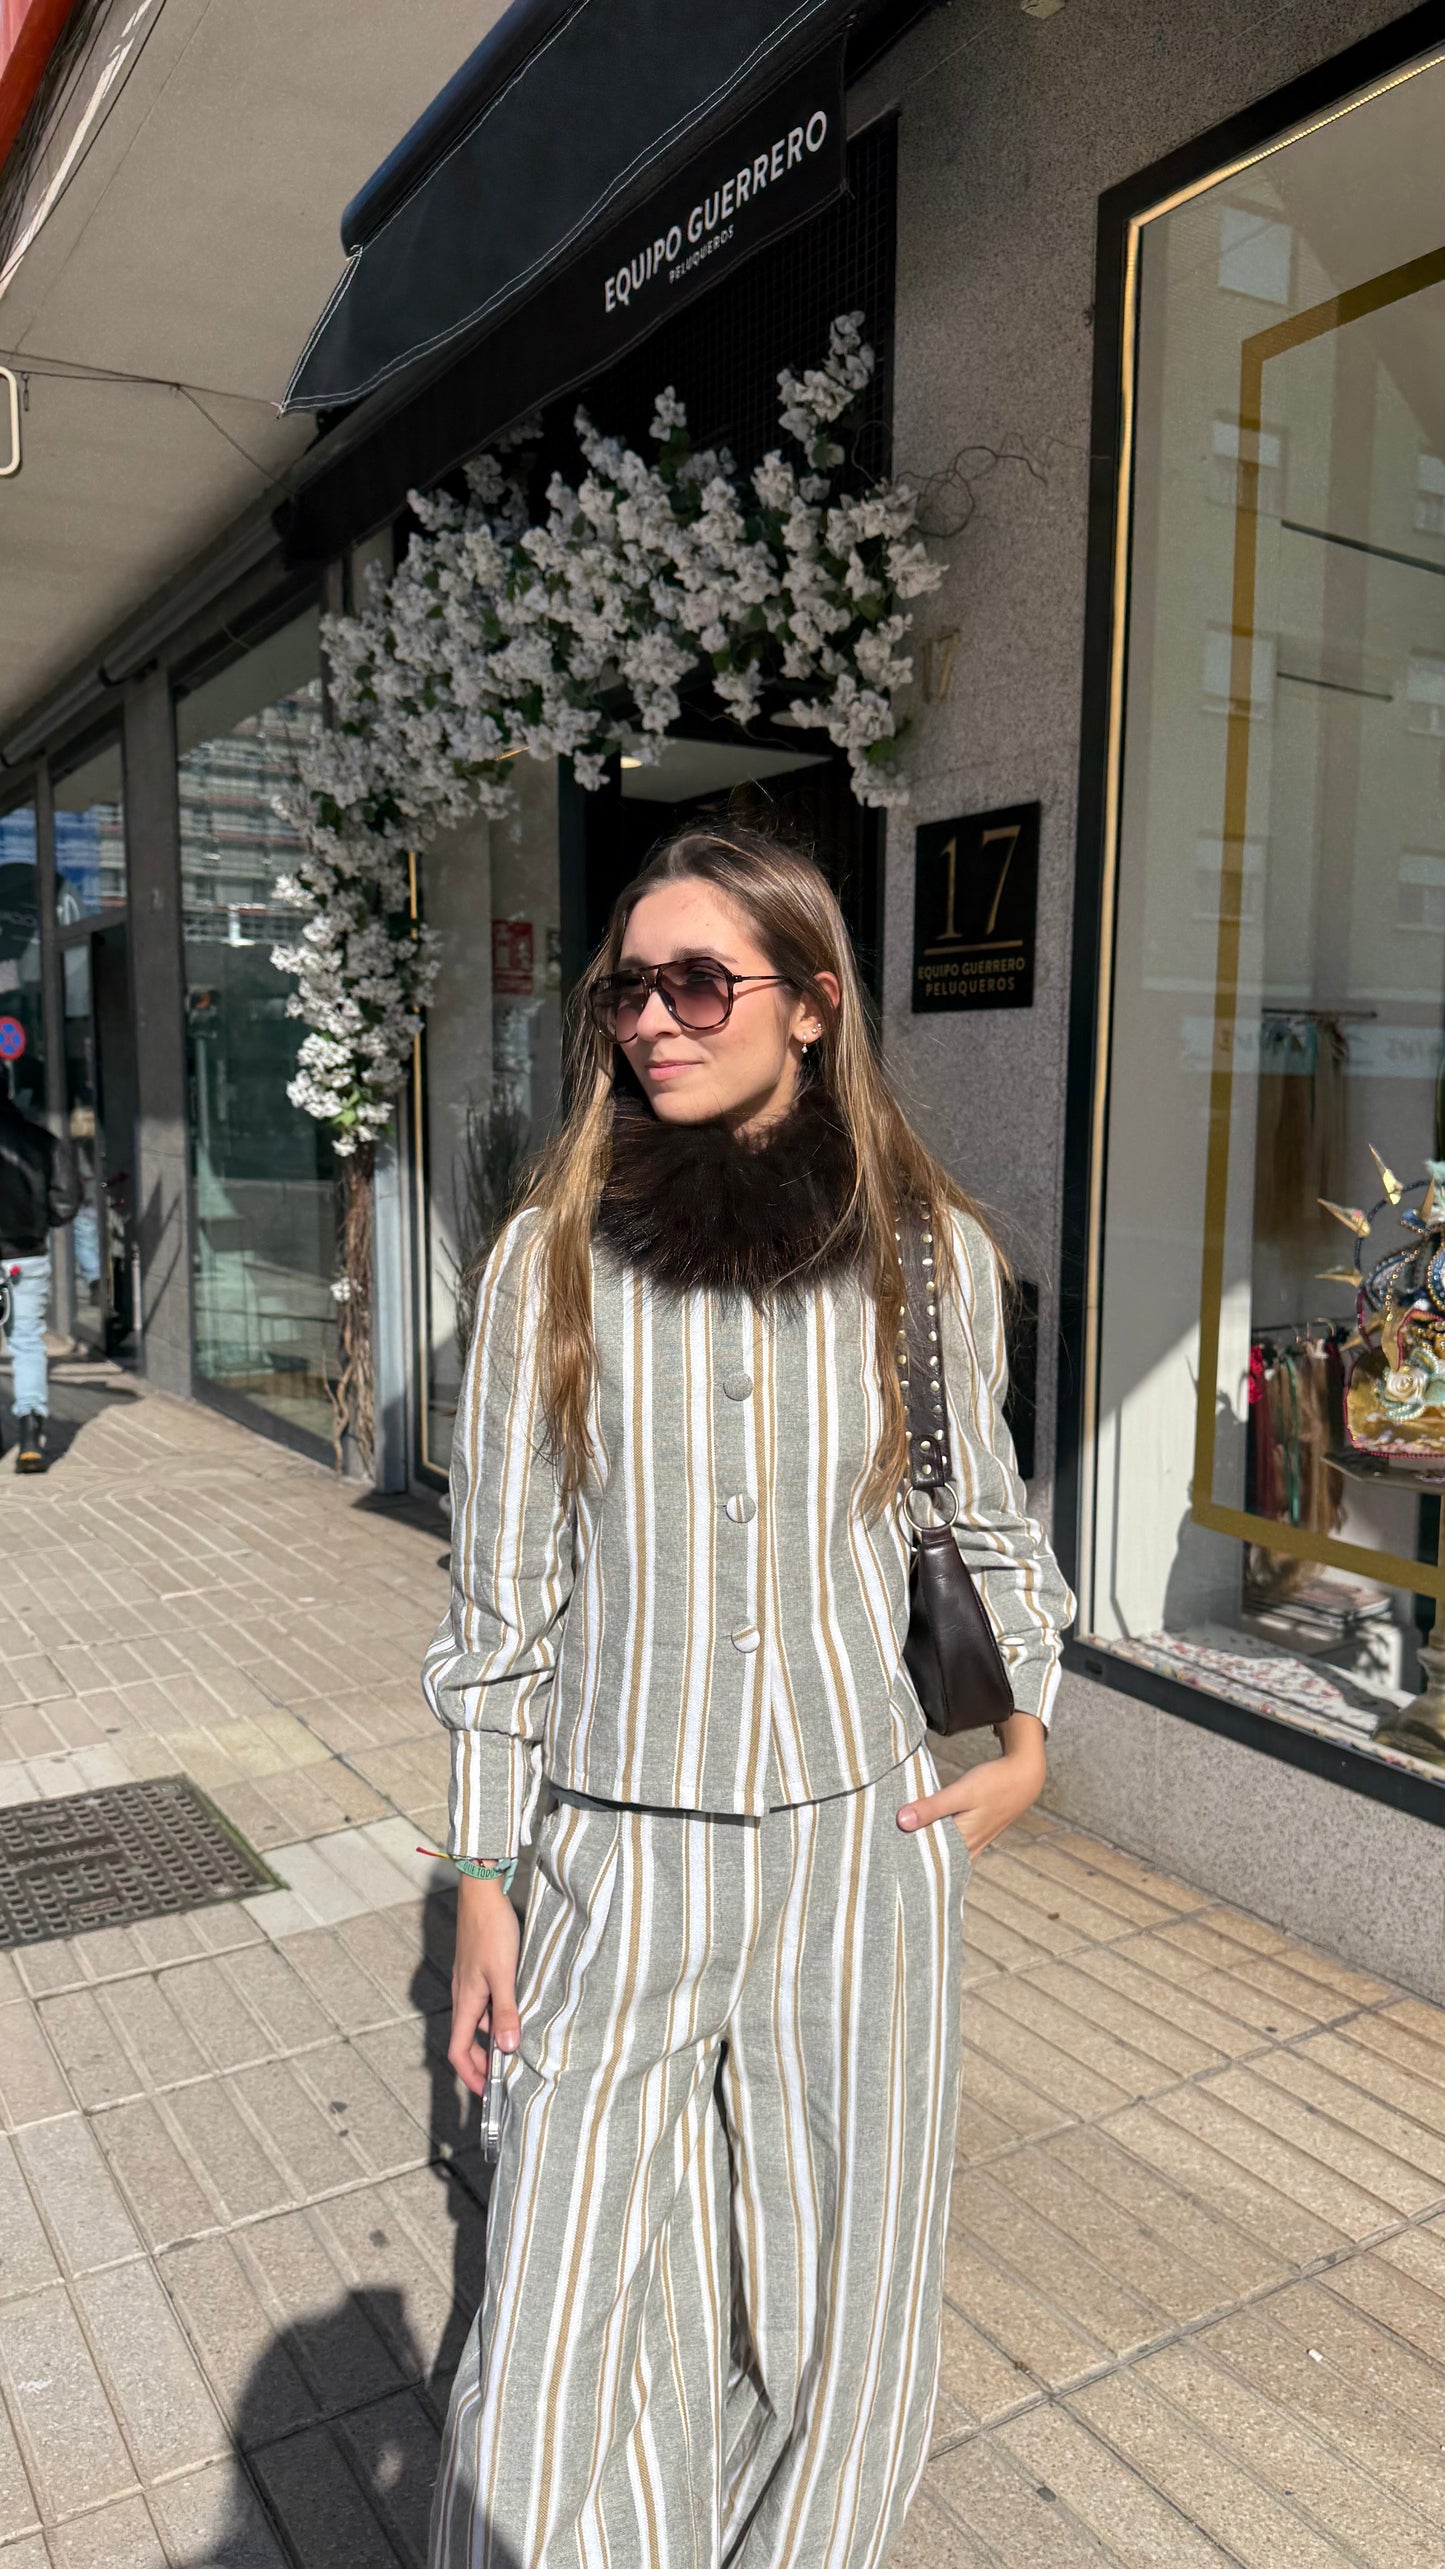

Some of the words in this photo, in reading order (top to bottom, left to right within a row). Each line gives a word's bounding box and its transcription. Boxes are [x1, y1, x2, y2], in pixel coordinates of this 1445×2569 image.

[604, 226, 682, 313] EQUIPO
[687, 110, 827, 243] GUERRERO
[669, 224, 734, 284] PELUQUEROS
[937, 825, 1021, 940] 17
[918, 963, 959, 981] EQUIPO
[962, 957, 1025, 976] GUERRERO
[925, 976, 1015, 997] PELUQUEROS
[464, 1861, 475, 1875] QUE
